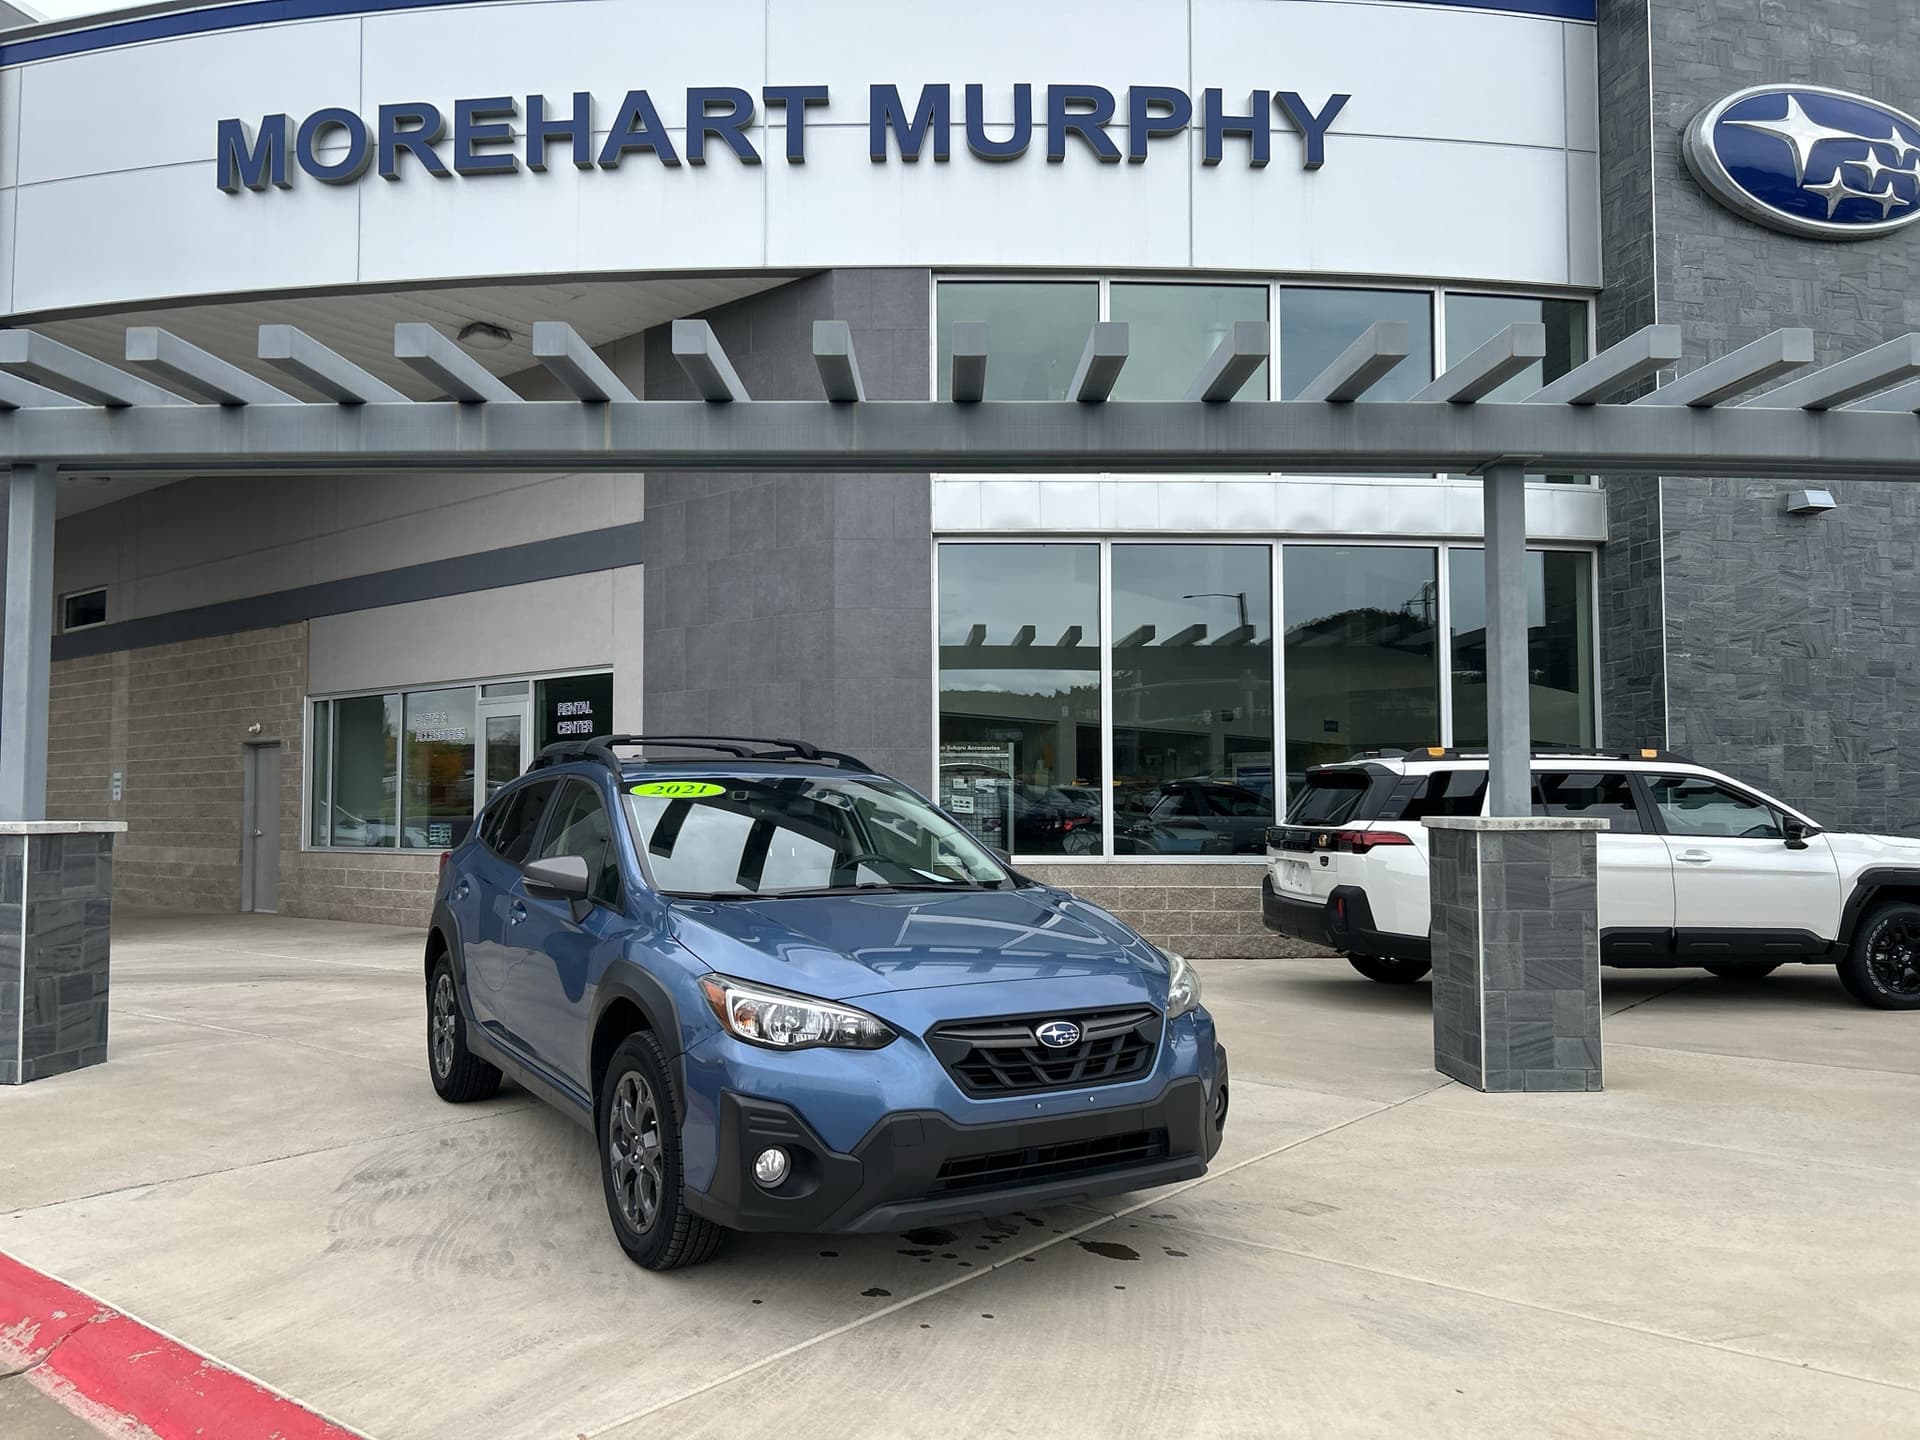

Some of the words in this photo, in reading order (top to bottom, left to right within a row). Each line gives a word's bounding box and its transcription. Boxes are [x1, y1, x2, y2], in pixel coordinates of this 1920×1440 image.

[217, 85, 829, 194] MOREHART
[869, 83, 1352, 170] MURPHY
[557, 700, 593, 716] RENTAL
[557, 719, 593, 735] CENTER
[650, 784, 708, 795] 2021
